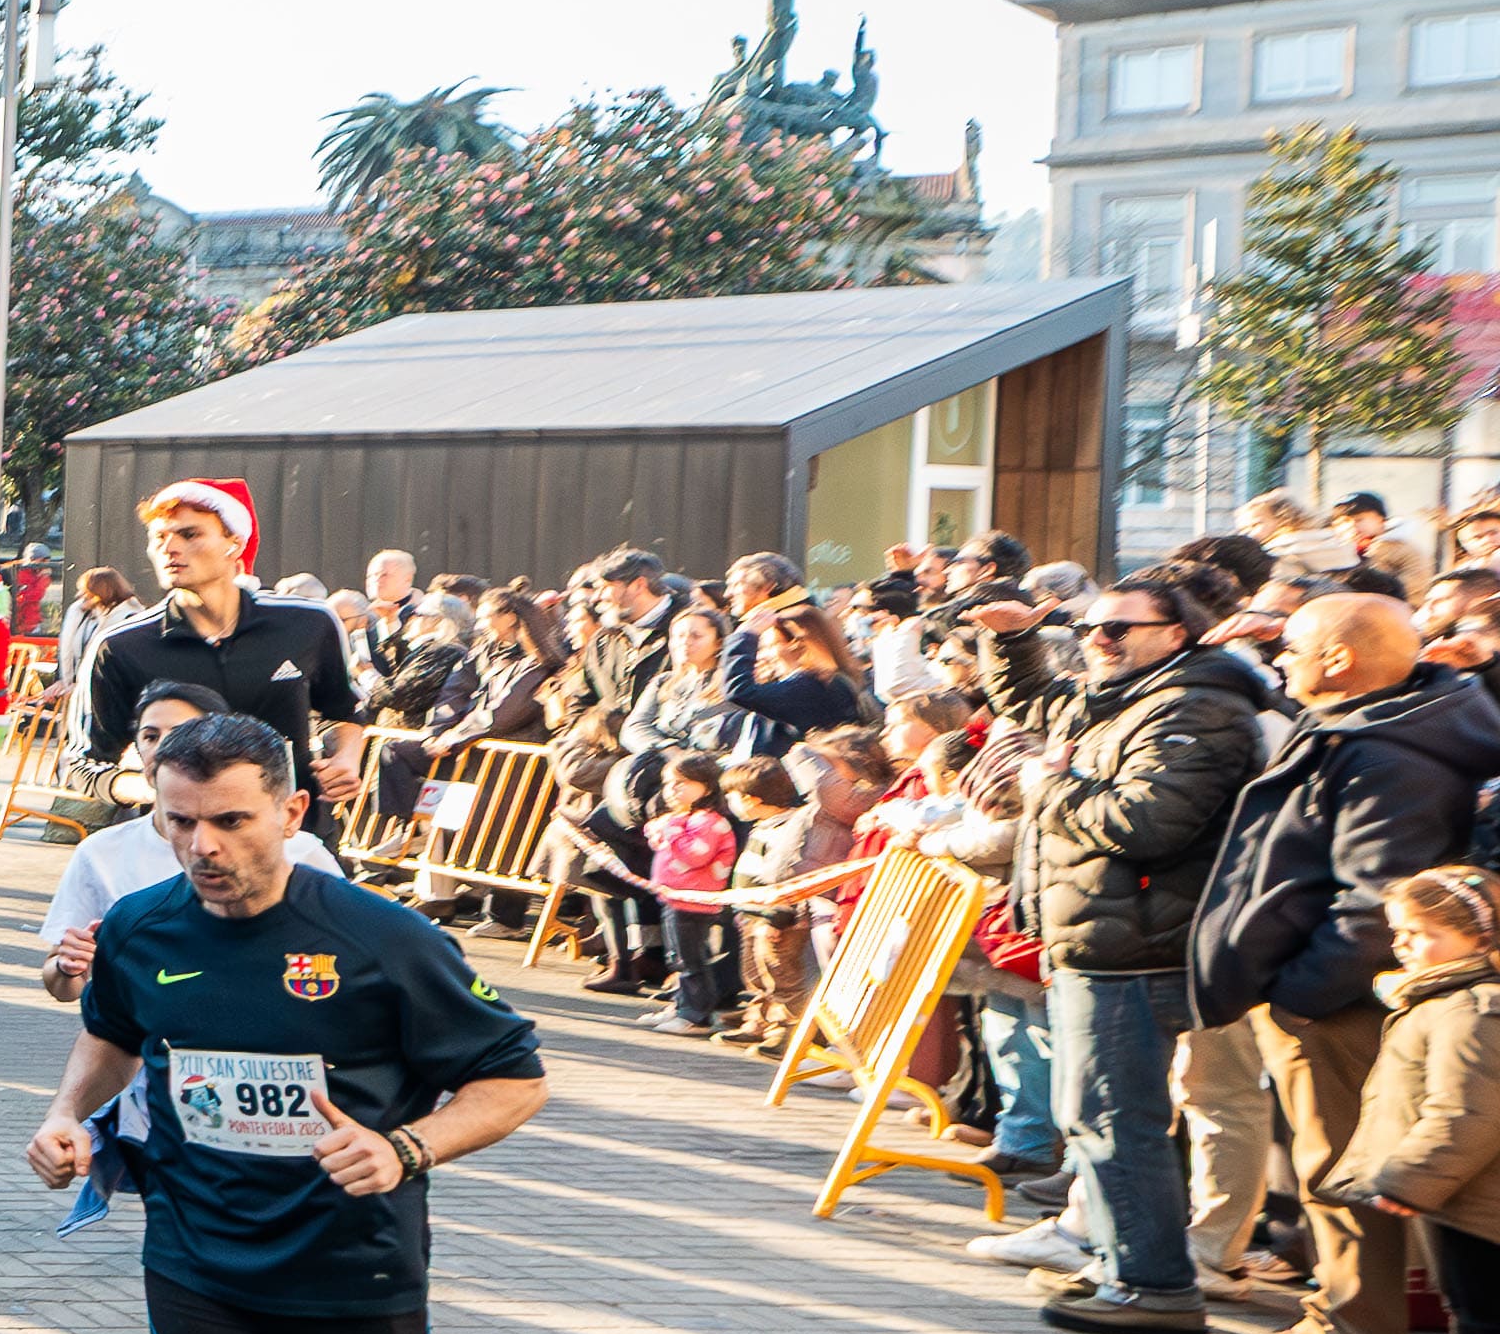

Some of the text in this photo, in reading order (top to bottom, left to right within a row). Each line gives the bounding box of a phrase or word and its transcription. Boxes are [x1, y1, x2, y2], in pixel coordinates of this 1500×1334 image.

[178, 1055, 317, 1081] XLII SAN SILVESTRE
[235, 1083, 310, 1117] 982
[227, 1119, 326, 1136] PONTEVEDRA 2025
